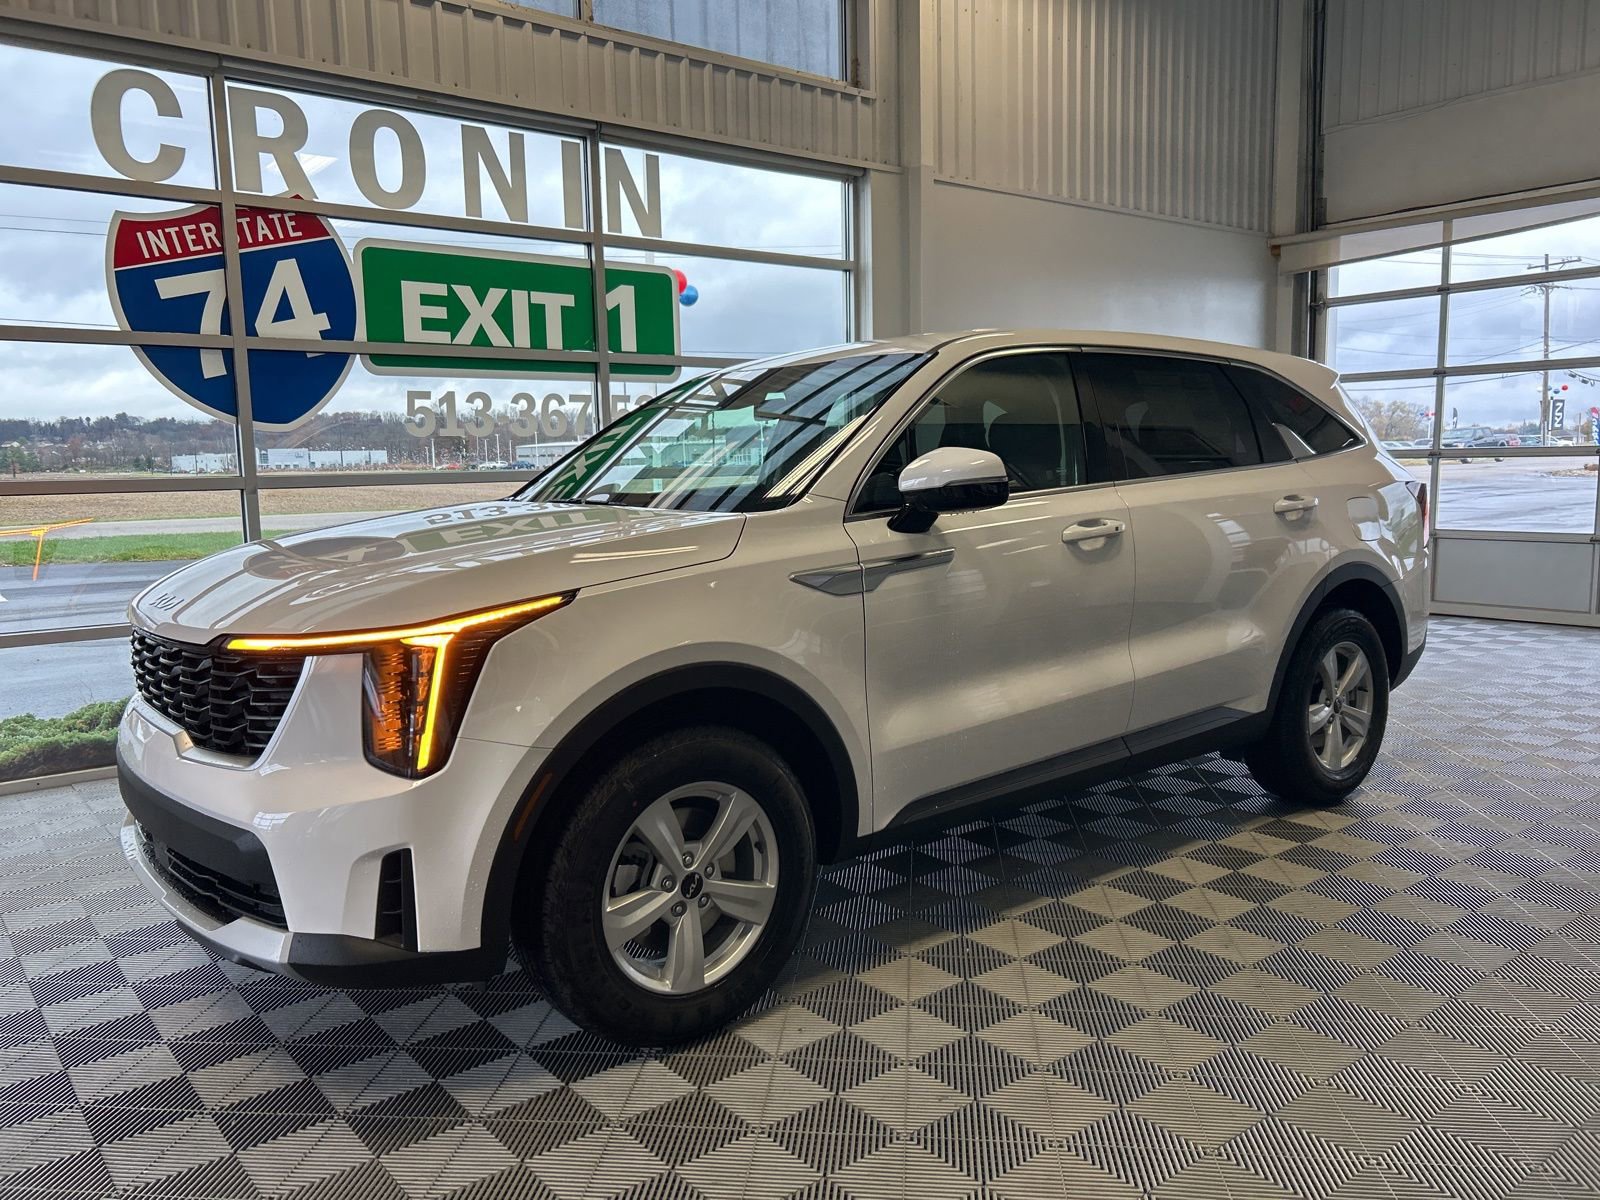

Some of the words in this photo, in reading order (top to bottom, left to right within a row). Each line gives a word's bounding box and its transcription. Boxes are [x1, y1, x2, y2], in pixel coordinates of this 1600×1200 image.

[90, 68, 663, 239] CRONIN
[135, 211, 303, 259] INTERTATE
[154, 257, 332, 380] 74
[400, 280, 576, 350] EXIT
[606, 284, 637, 352] 1
